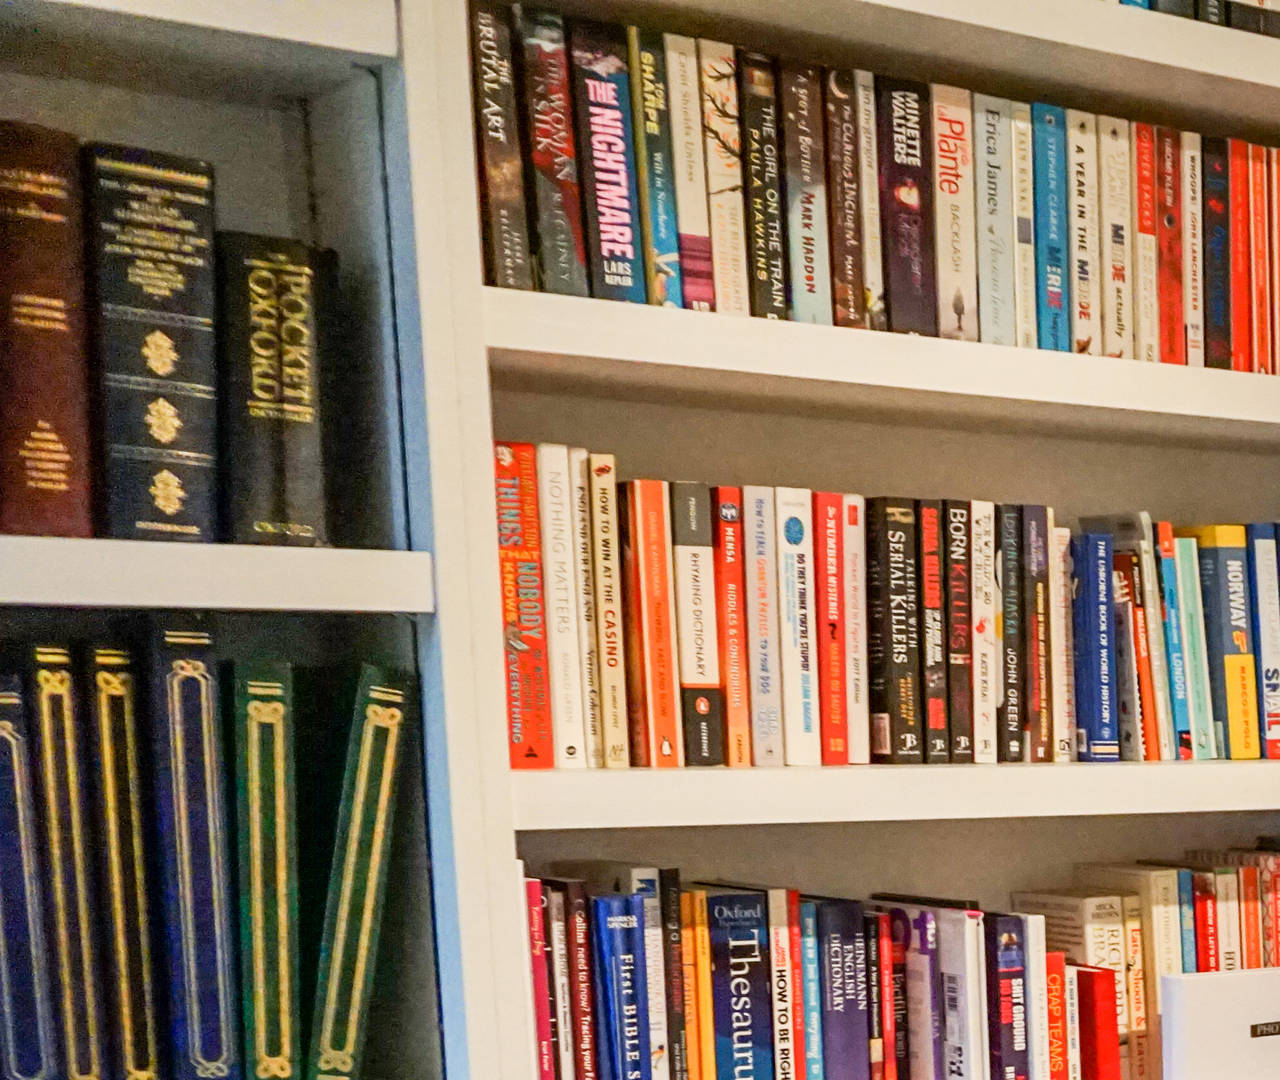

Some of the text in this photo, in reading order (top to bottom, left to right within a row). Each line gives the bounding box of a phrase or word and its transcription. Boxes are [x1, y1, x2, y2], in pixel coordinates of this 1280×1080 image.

[478, 11, 499, 93] BRUTAL
[483, 98, 505, 142] ART
[891, 90, 921, 168] MINETTE WALTERS
[589, 105, 635, 260] NIGHTMARE
[936, 117, 966, 195] Plante
[985, 108, 1001, 217] Erica James
[1076, 165, 1086, 198] YEAR
[751, 129, 767, 281] PAULA HAWKINS
[761, 105, 785, 308] THE GIRL ON THE TRAIN
[1077, 203, 1086, 219] IN
[1142, 185, 1153, 227] SACKS
[603, 260, 633, 275] LARS
[800, 192, 817, 294] MARK HADDON
[1077, 227, 1088, 251] THE
[1191, 240, 1199, 311] LANCHESTER
[248, 268, 279, 400] OXFORD
[280, 275, 313, 402] POCKET
[497, 478, 521, 547] THINGS
[949, 508, 967, 560] BORN
[548, 471, 570, 634] NOTHING MATTERS
[598, 488, 618, 668] HOW TO WIN AT THE CASINO
[724, 528, 736, 563] MENSA
[503, 561, 517, 622] KNOWS
[517, 561, 542, 639] NOBODY
[690, 553, 705, 676] RHYMING DICTIONARY
[727, 584, 738, 625] RIDDLES
[887, 531, 908, 664] SERIAL KILLERS
[905, 558, 918, 647] TALKING WITH
[1226, 560, 1246, 631] NORWAY
[1007, 647, 1018, 682] JOHN
[1097, 541, 1110, 724] THE USBORNE BOOK OF WORLD HISTORY
[507, 653, 524, 744] EVERYTHING
[586, 651, 599, 735] Vernon Coleman
[1172, 652, 1186, 700] LONDON
[1007, 688, 1019, 732] GREEN
[574, 911, 585, 943] Collins
[713, 905, 760, 918] Oxford
[576, 948, 586, 970] need
[578, 971, 587, 982] to
[620, 954, 634, 995] First
[776, 970, 787, 1002] HOW
[830, 933, 844, 1012] DICTIONARY
[843, 945, 855, 999] ENGLISH
[855, 933, 867, 1010] HEINEMANN
[579, 983, 590, 1011] know?
[777, 1008, 788, 1024] TO
[1010, 978, 1026, 1051] SHIT GROUND
[1046, 973, 1063, 1072] CRAP TEAMS
[579, 1015, 592, 1048] Tracing
[581, 1050, 591, 1071] your
[623, 1004, 639, 1061] BIBLE
[779, 1028, 789, 1043] BE
